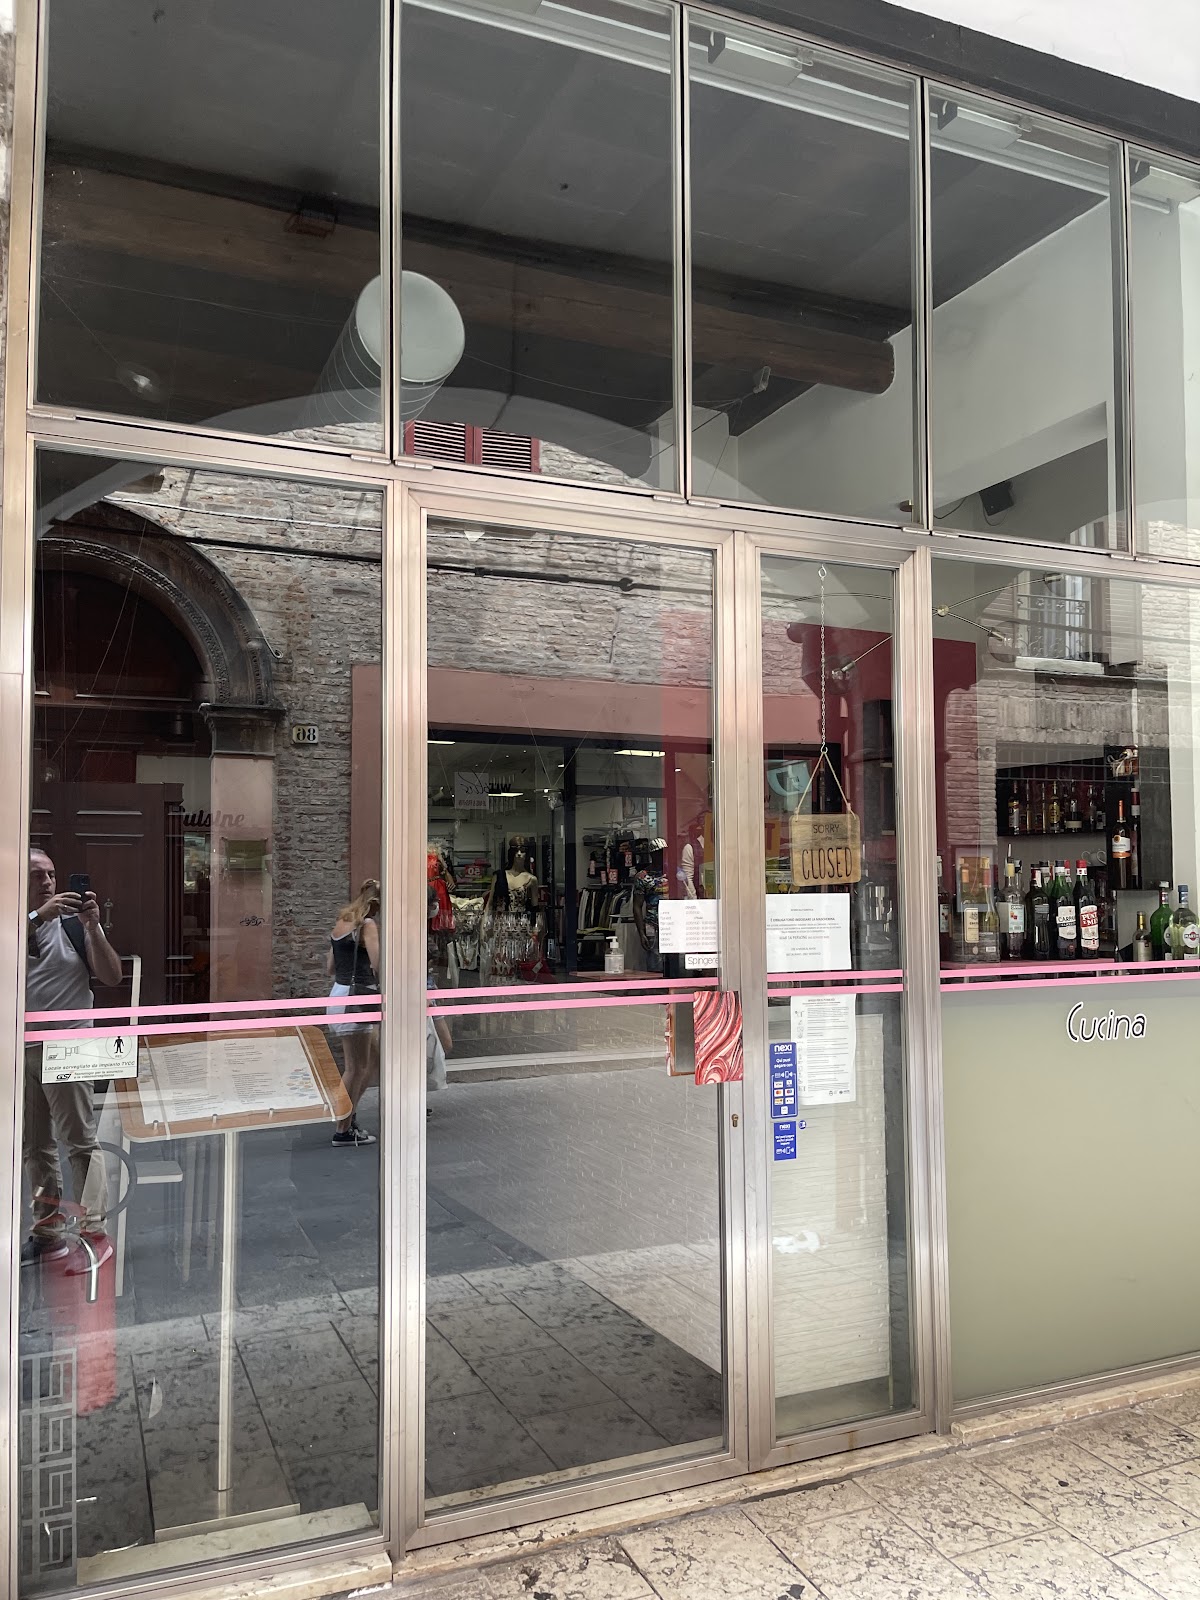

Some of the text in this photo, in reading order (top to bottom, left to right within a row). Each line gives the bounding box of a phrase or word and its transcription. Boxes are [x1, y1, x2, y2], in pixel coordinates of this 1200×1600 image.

[182, 809, 246, 829] uisine
[813, 824, 840, 834] SORRY
[802, 846, 853, 881] CLOSED
[687, 956, 719, 967] Spingere
[1066, 1001, 1147, 1043] Cucina
[774, 1044, 792, 1052] nexi
